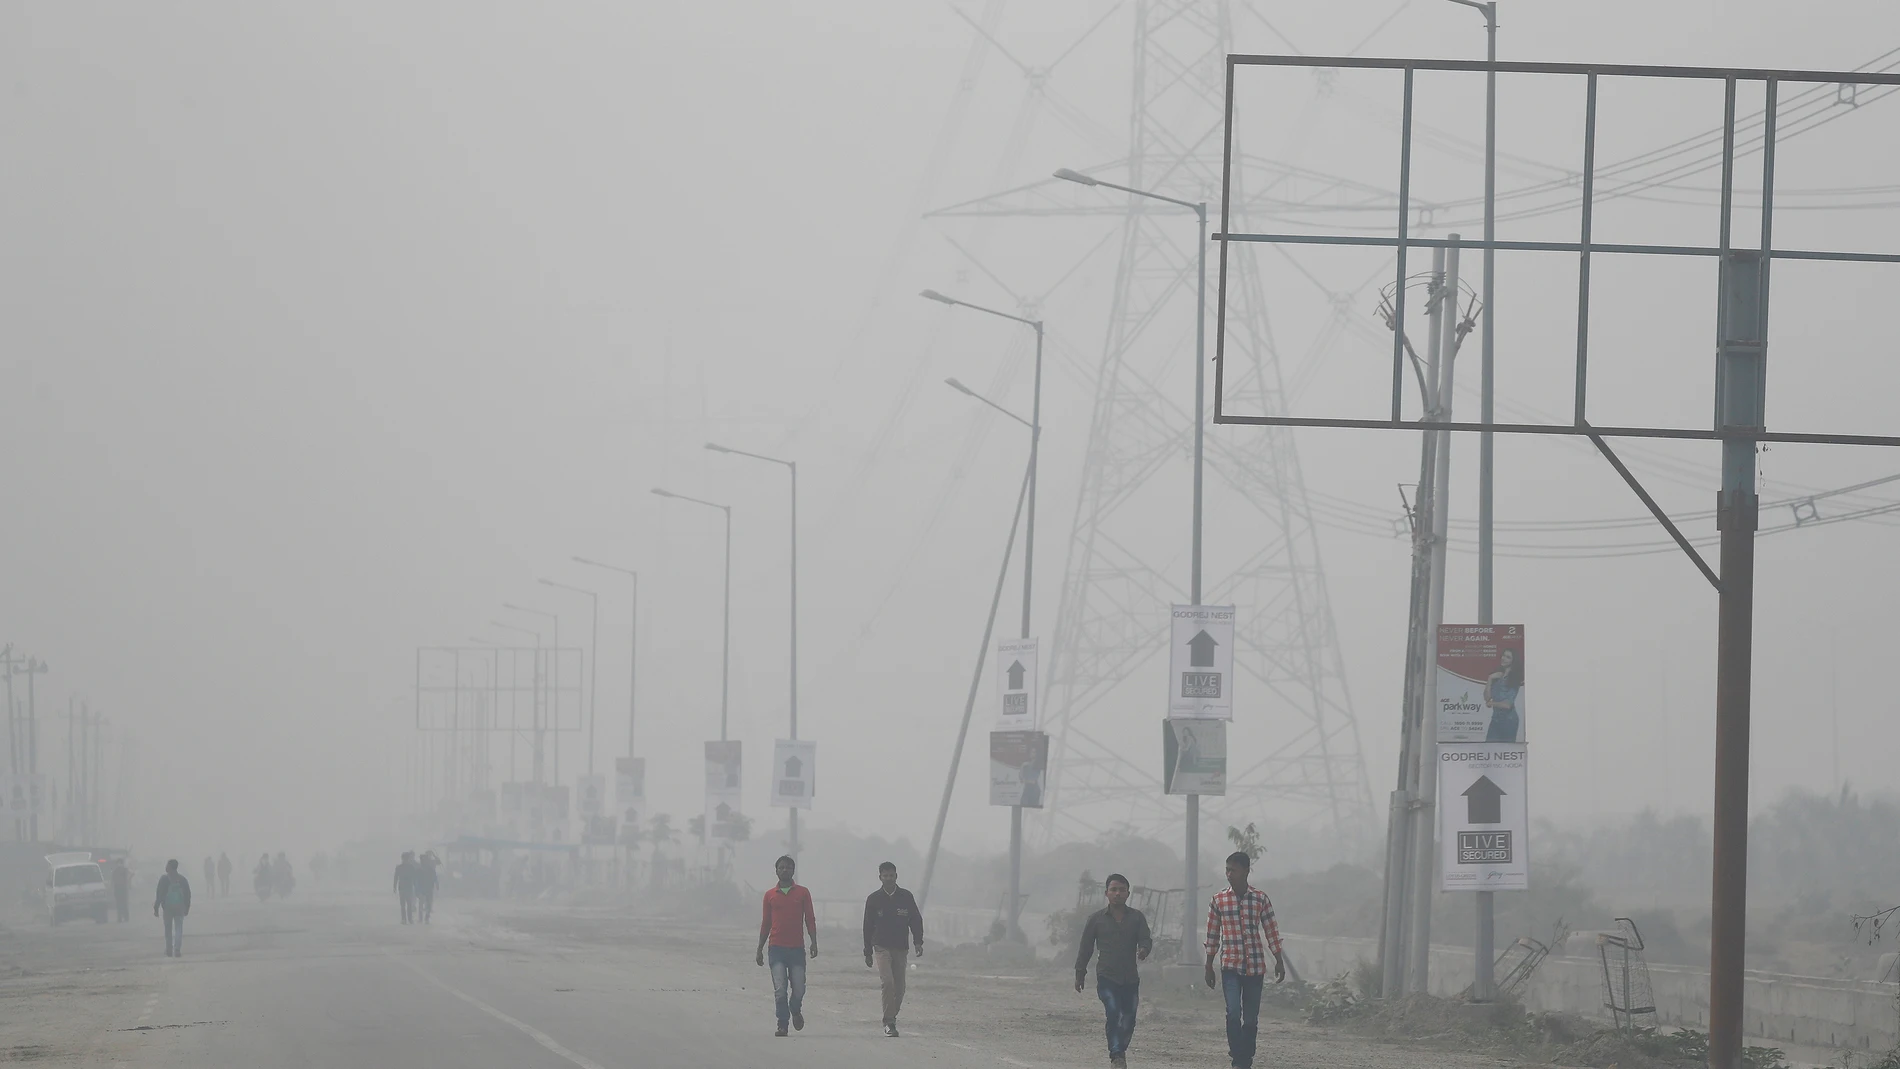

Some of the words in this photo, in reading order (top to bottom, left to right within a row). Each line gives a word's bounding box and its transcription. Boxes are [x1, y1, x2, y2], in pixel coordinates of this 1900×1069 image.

[1185, 675, 1217, 687] LIVE
[1185, 687, 1217, 695] SECURED
[1443, 702, 1482, 712] parkway
[1441, 752, 1491, 761] GODREJ
[1494, 752, 1525, 760] NEST
[1463, 834, 1506, 849] LIVE
[1462, 851, 1507, 860] SECURED
